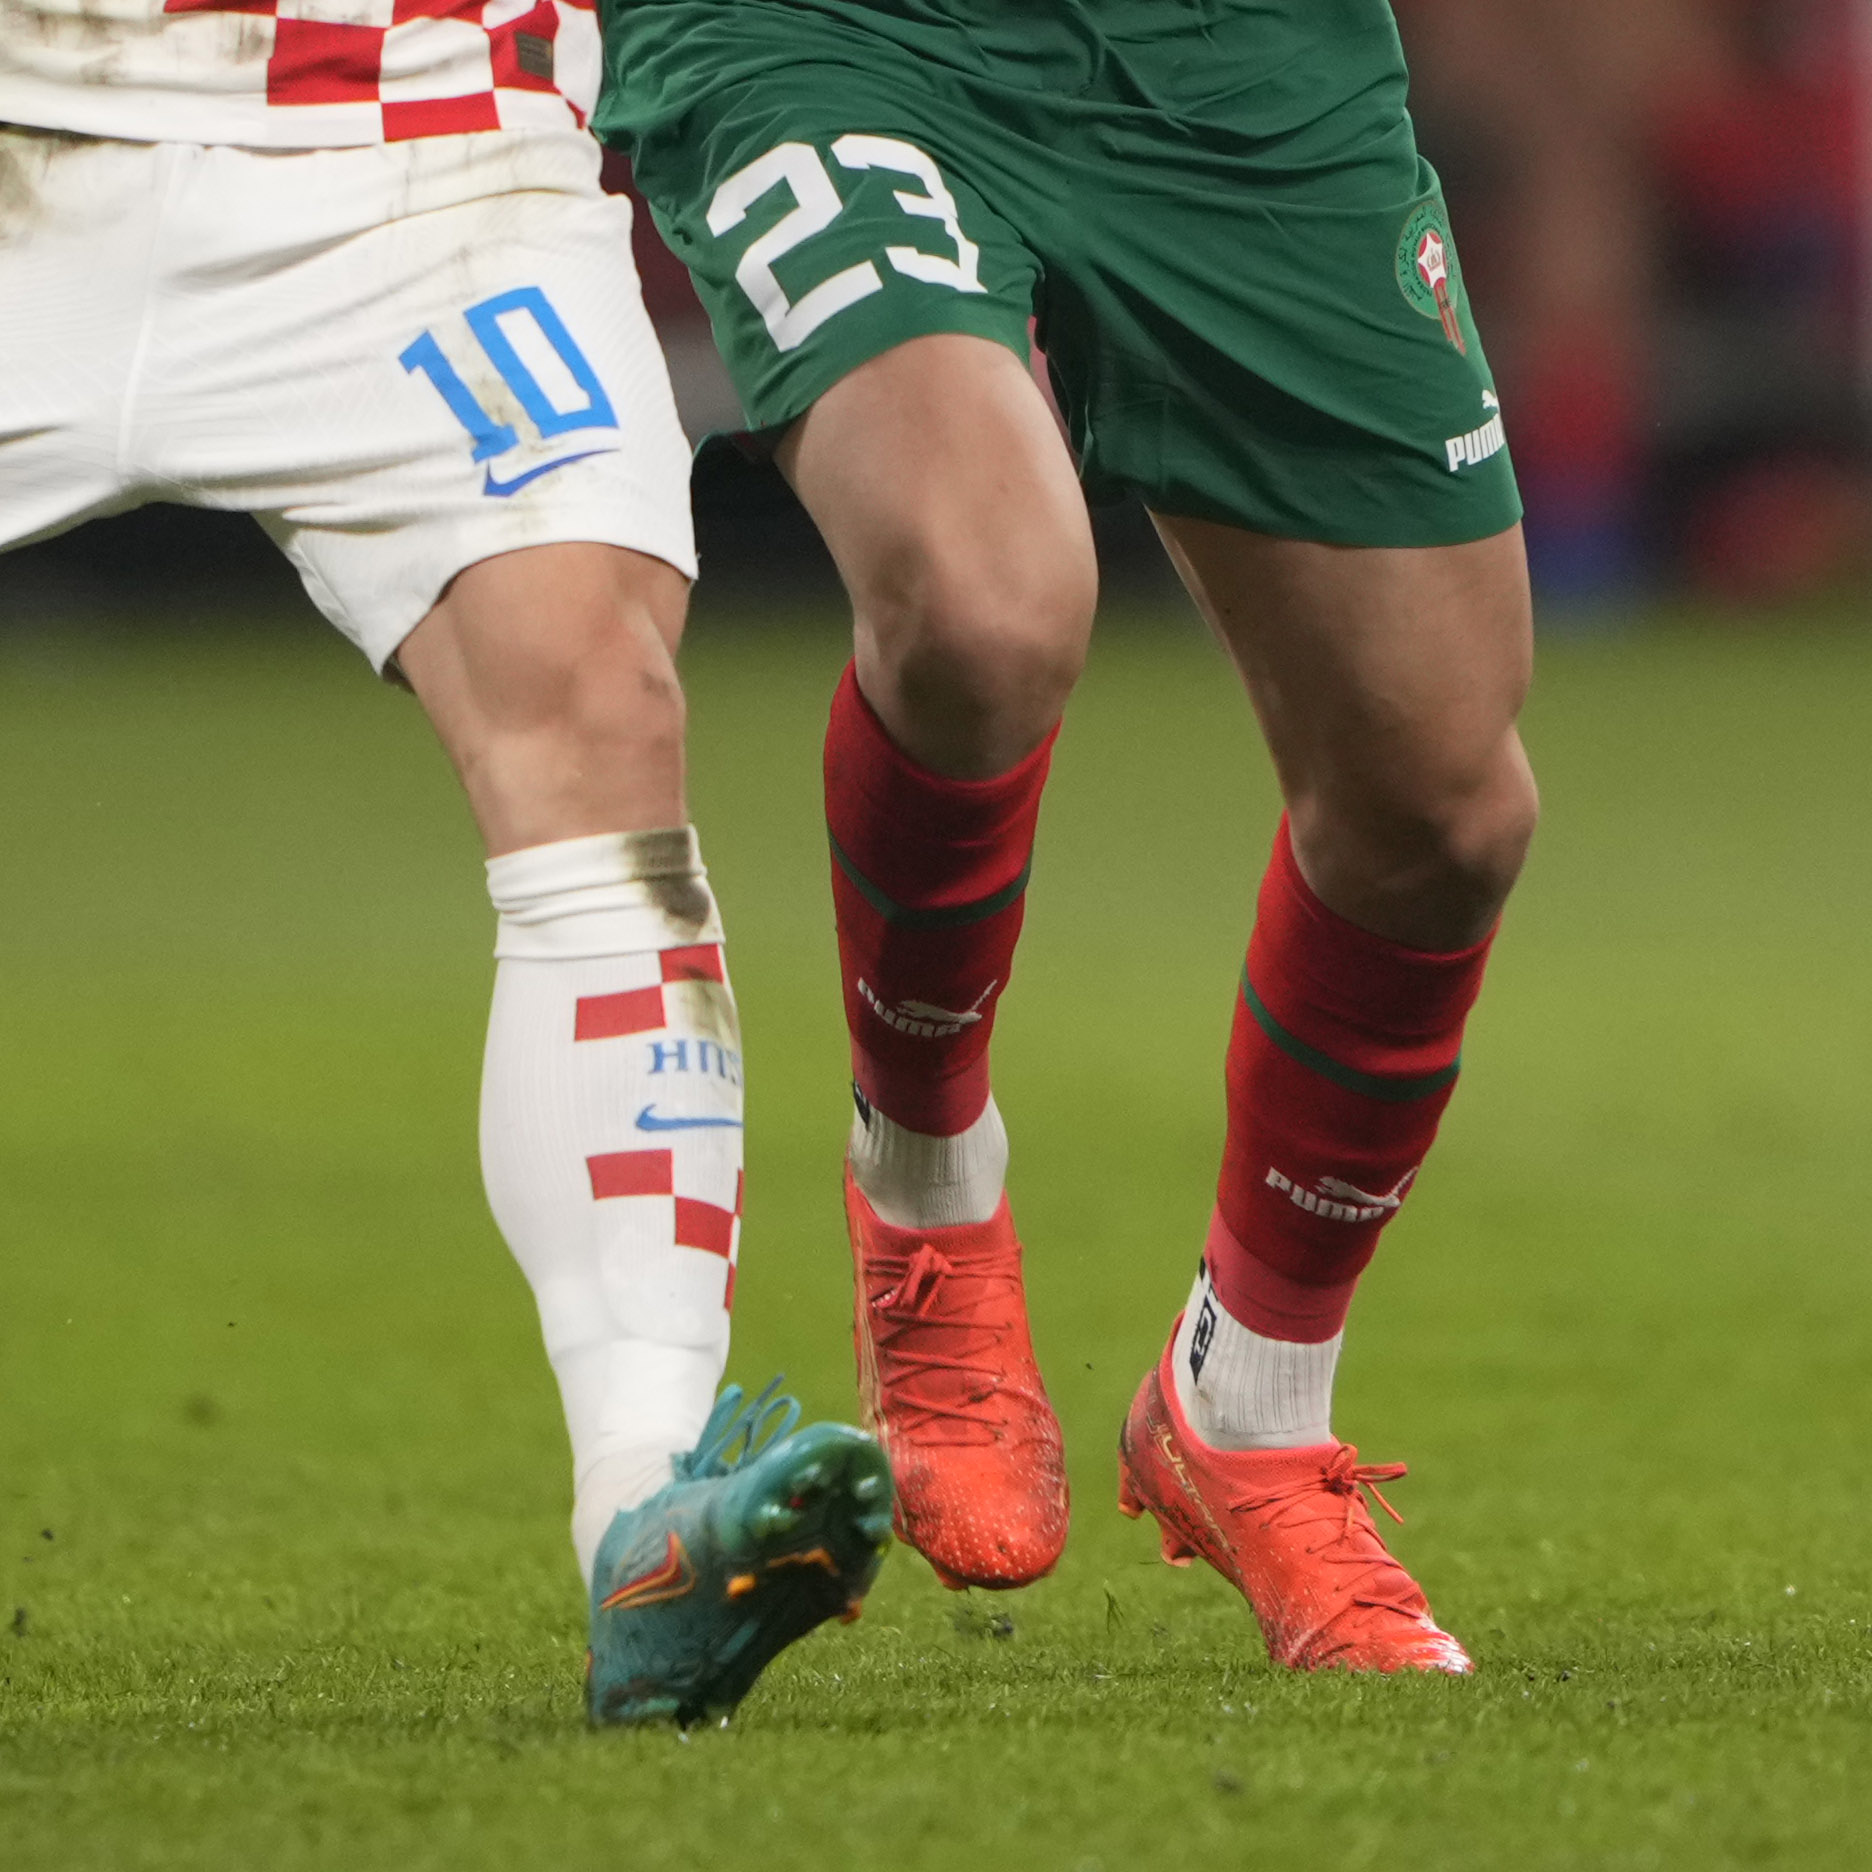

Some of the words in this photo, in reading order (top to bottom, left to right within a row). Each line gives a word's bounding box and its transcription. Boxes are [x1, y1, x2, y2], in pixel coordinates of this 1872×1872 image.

[706, 134, 988, 352] 23
[398, 286, 619, 464] 10
[1265, 1165, 1385, 1223] PUMA
